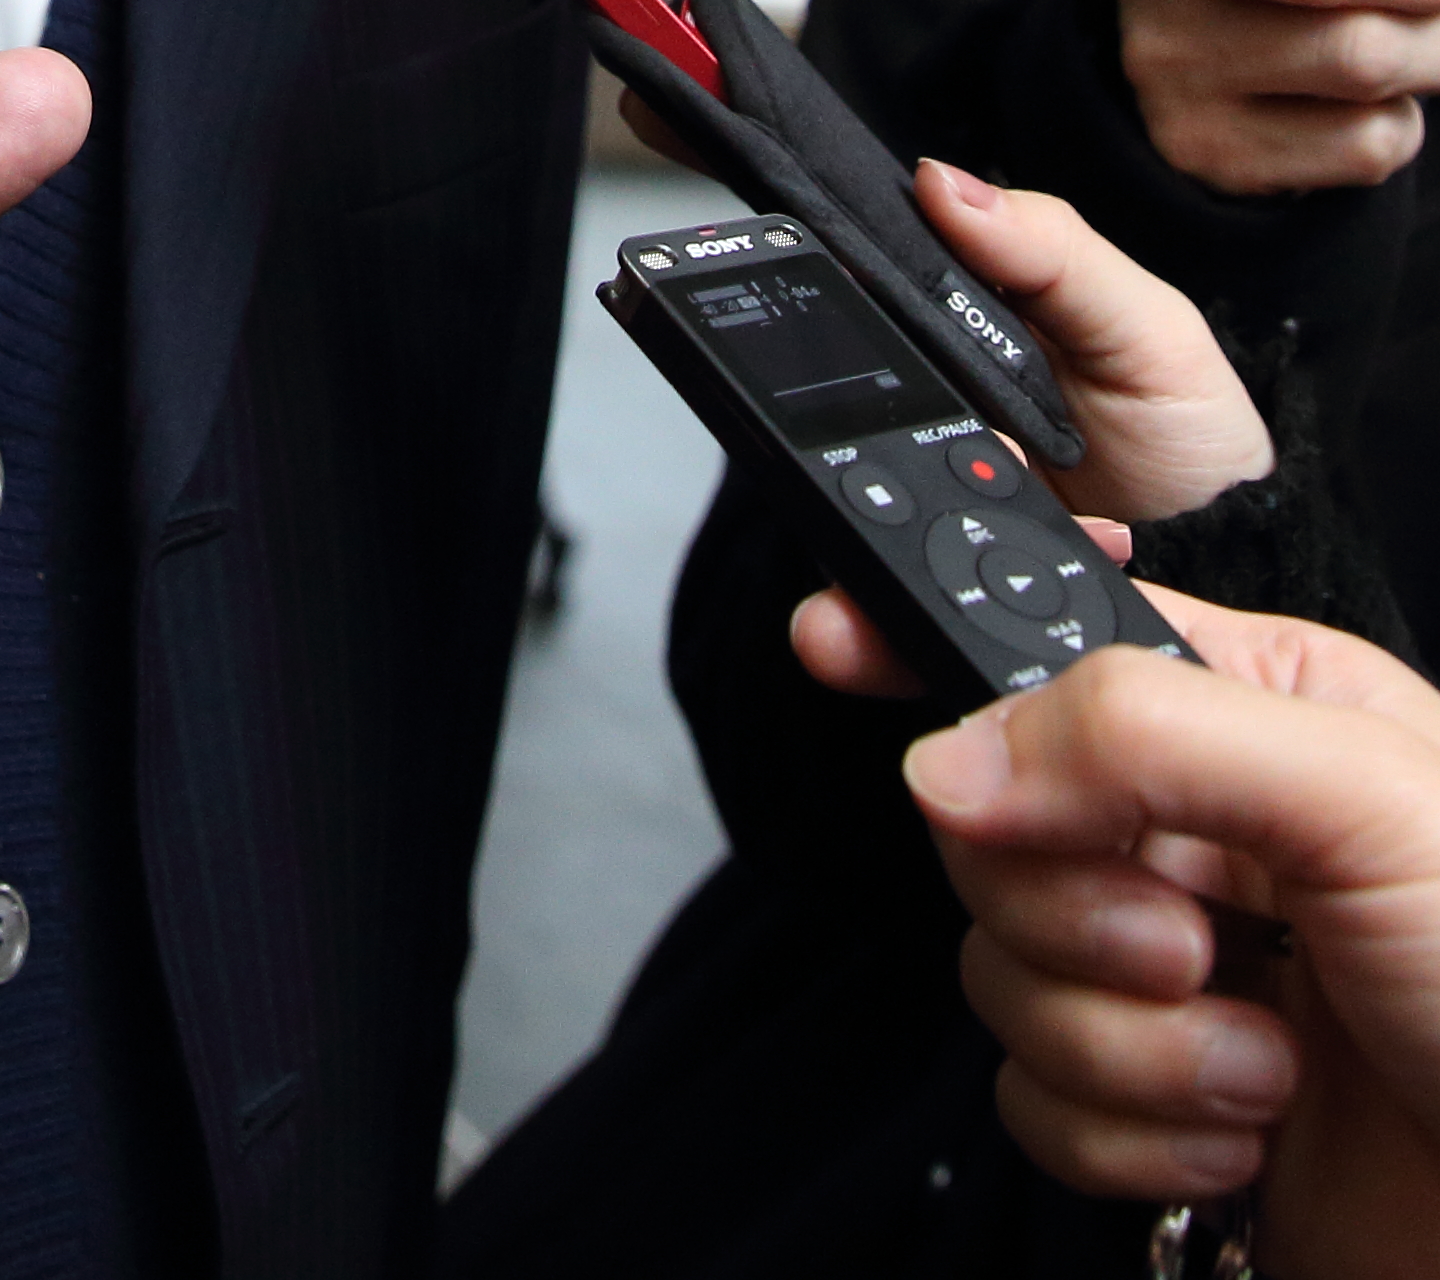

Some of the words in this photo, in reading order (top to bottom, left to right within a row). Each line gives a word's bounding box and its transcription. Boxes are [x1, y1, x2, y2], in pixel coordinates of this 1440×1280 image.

[684, 234, 754, 259] SONY
[946, 291, 1023, 360] SONY
[911, 418, 983, 445] REC/PAUSE
[822, 446, 858, 466] STOP
